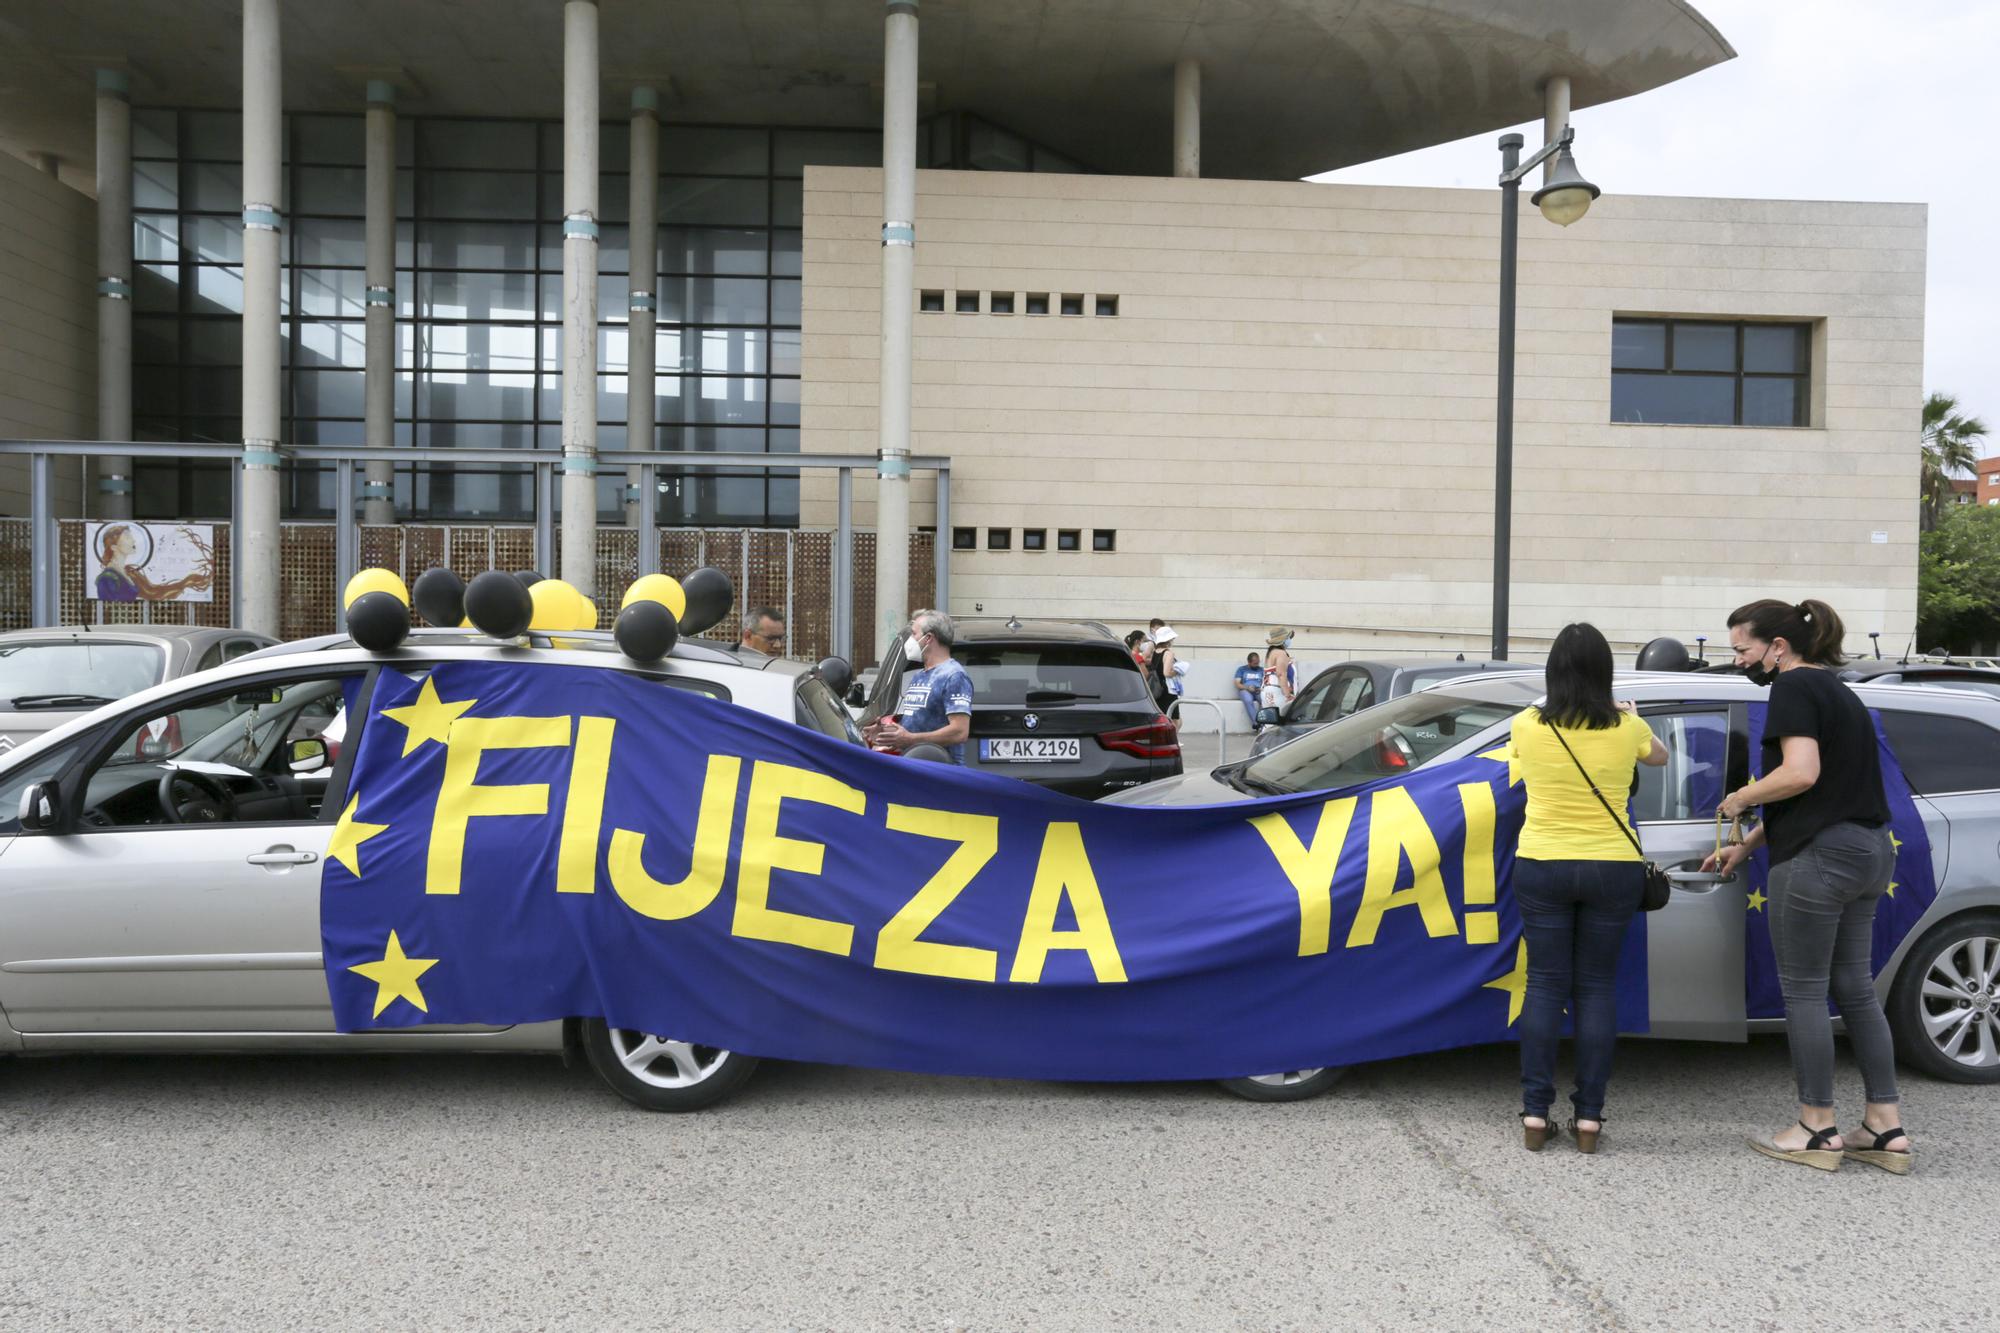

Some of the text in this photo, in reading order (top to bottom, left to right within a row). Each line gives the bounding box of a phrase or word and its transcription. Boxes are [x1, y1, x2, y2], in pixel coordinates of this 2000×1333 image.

[990, 741, 1078, 756] K AK 2196
[425, 715, 1499, 984] FIJEZA YA!
